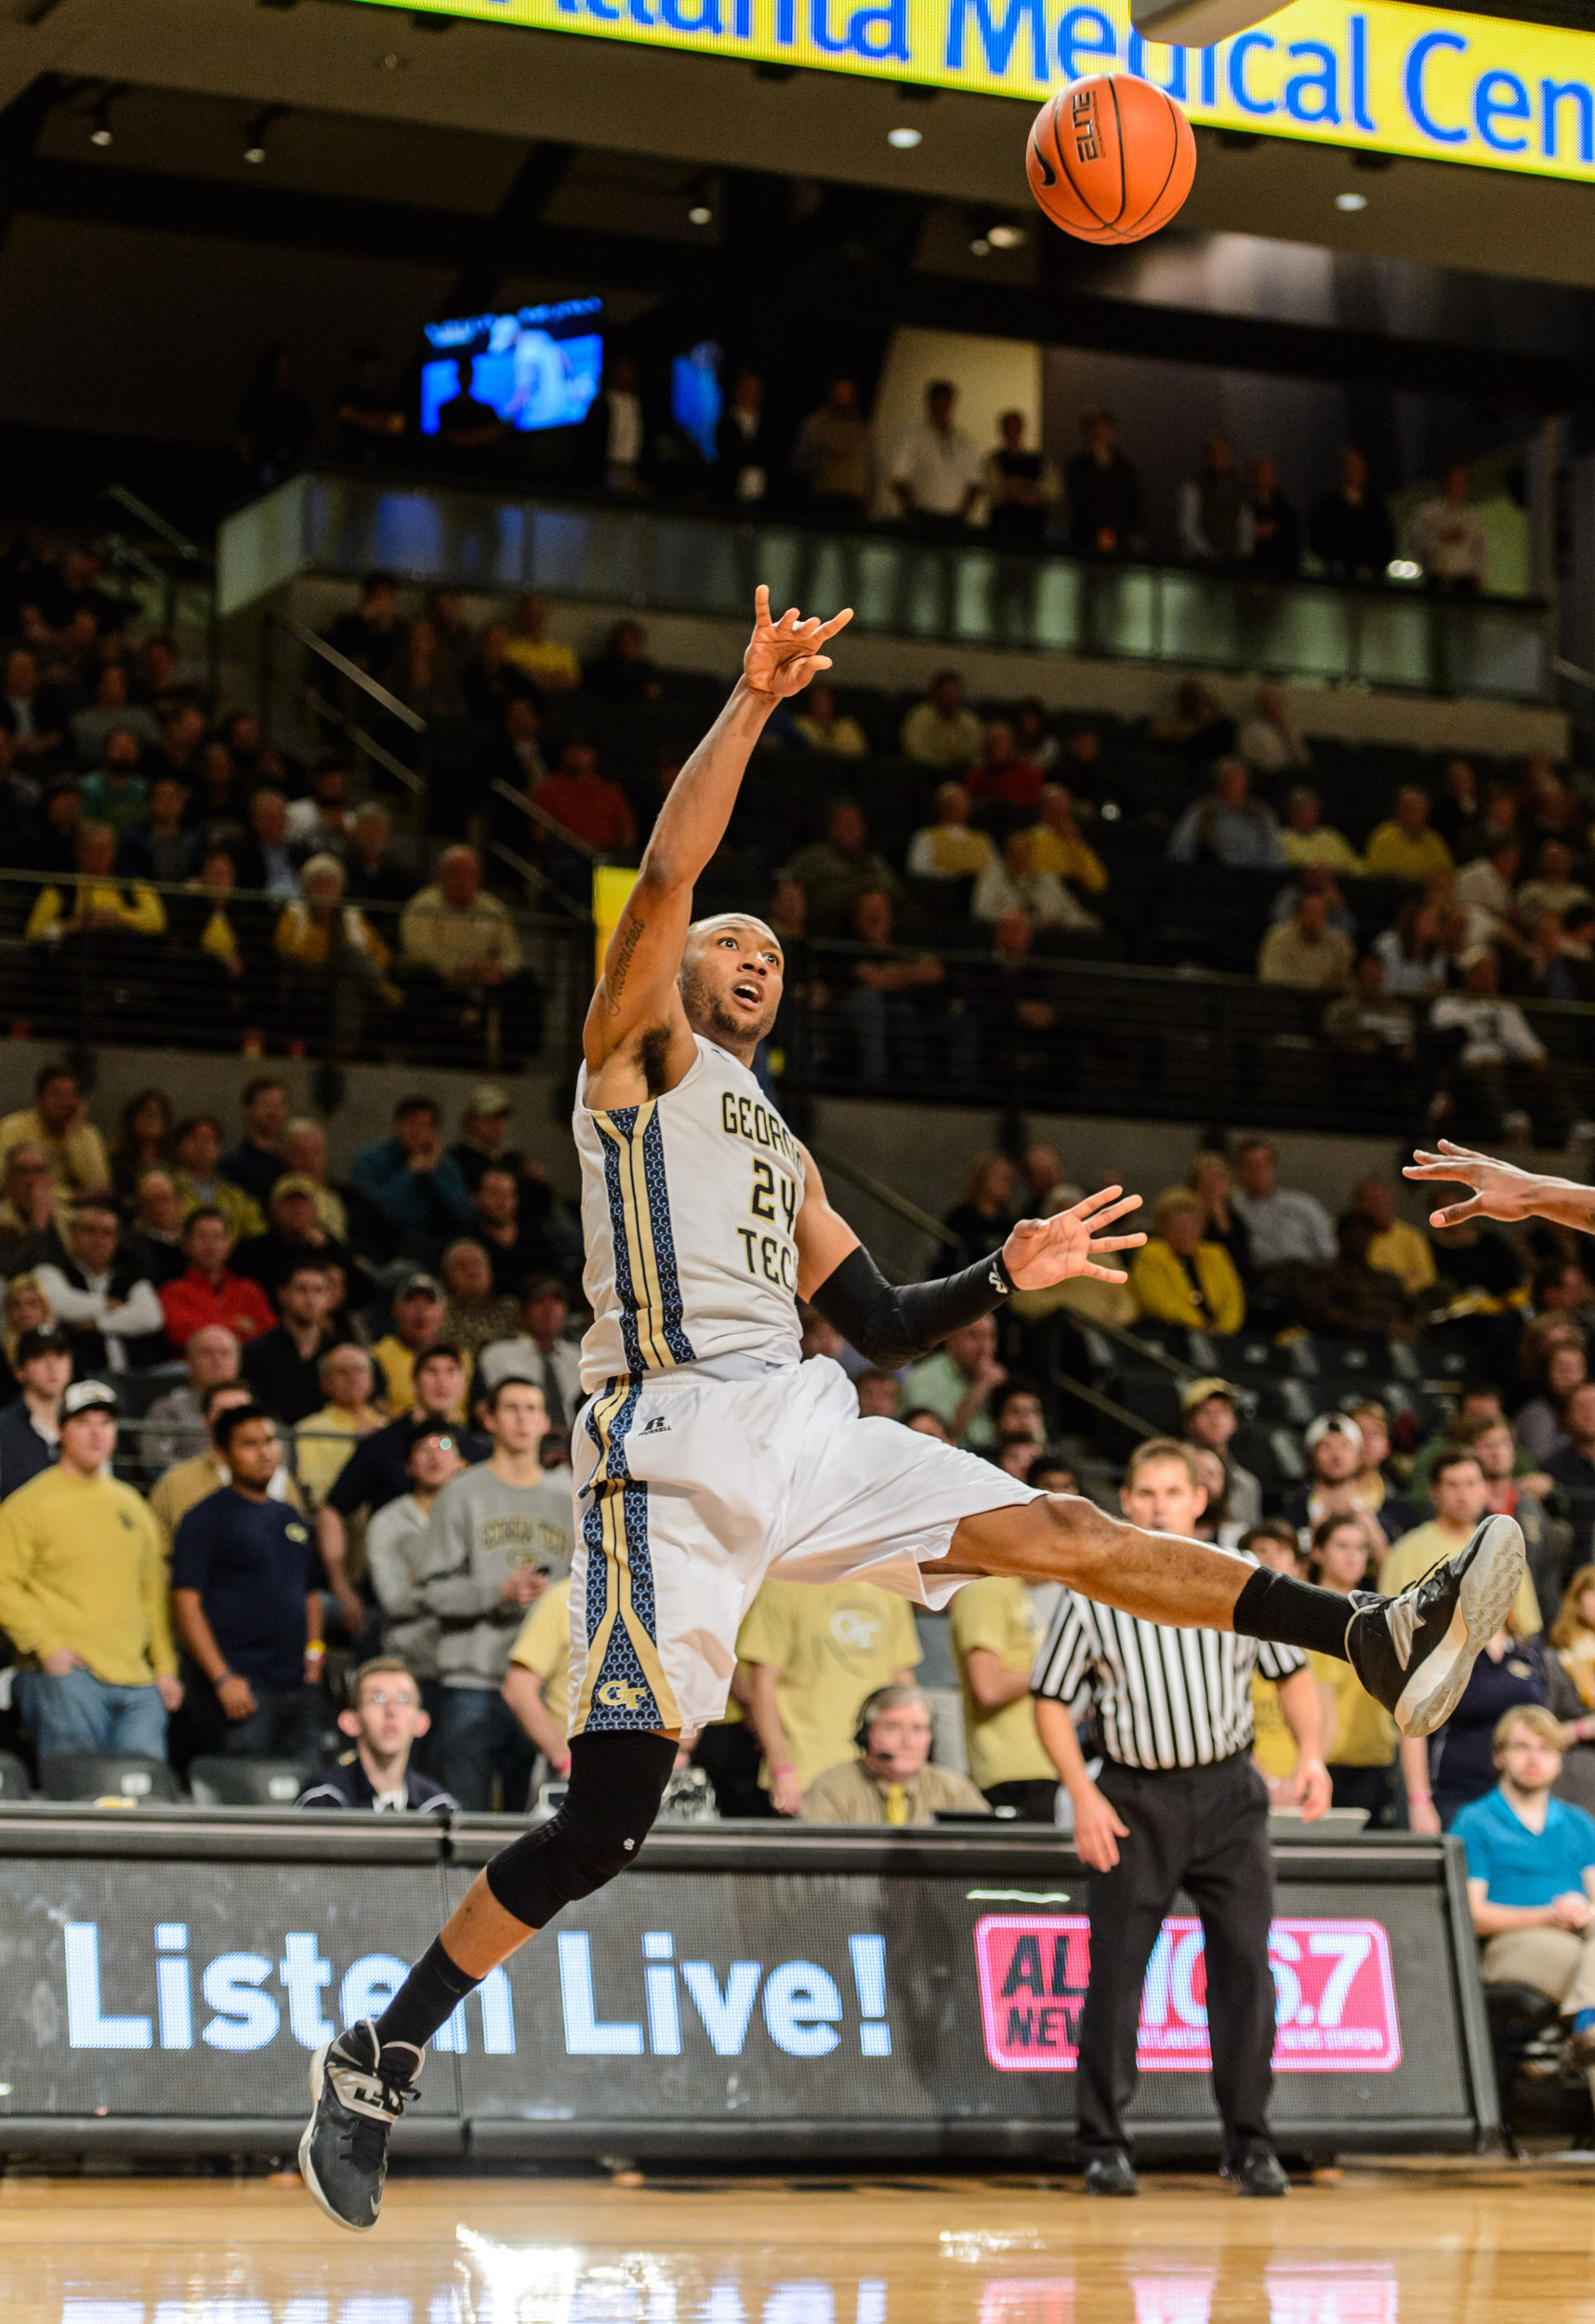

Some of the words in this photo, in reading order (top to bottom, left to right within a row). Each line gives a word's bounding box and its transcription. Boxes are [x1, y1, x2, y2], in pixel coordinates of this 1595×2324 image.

[1073, 91, 1099, 163] ELITE
[1404, 30, 1595, 164] Cen
[750, 1155, 797, 1235] 24
[735, 1225, 797, 1295] TEC
[64, 1921, 517, 2054] Listen
[558, 1931, 892, 2056] Live!
[1001, 1934, 1088, 1998] AL
